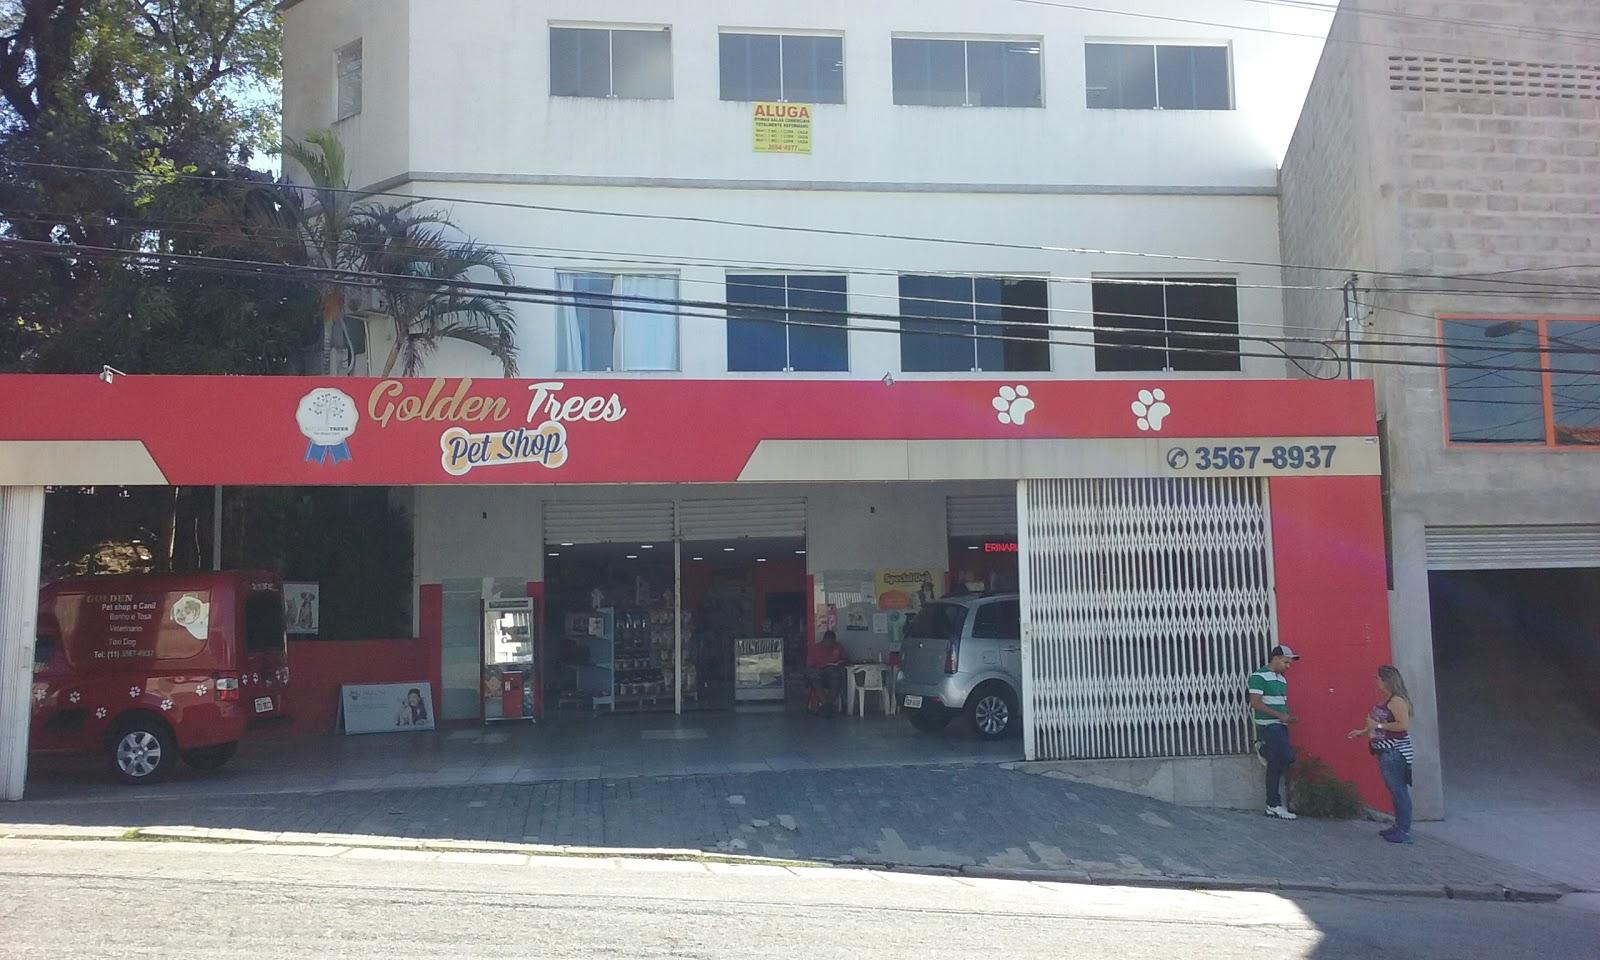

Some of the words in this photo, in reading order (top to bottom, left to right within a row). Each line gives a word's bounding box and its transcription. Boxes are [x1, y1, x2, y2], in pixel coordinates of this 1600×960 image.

[755, 105, 809, 118] ALUGA
[368, 377, 511, 428] Golden
[527, 382, 627, 423] Trees
[449, 436, 492, 465] Pet
[497, 428, 564, 464] Shop
[1195, 445, 1337, 470] 3567-8937
[87, 594, 133, 603] GOLDEN
[102, 603, 113, 611] Pet
[114, 602, 131, 611] shop
[139, 602, 157, 610] Canil
